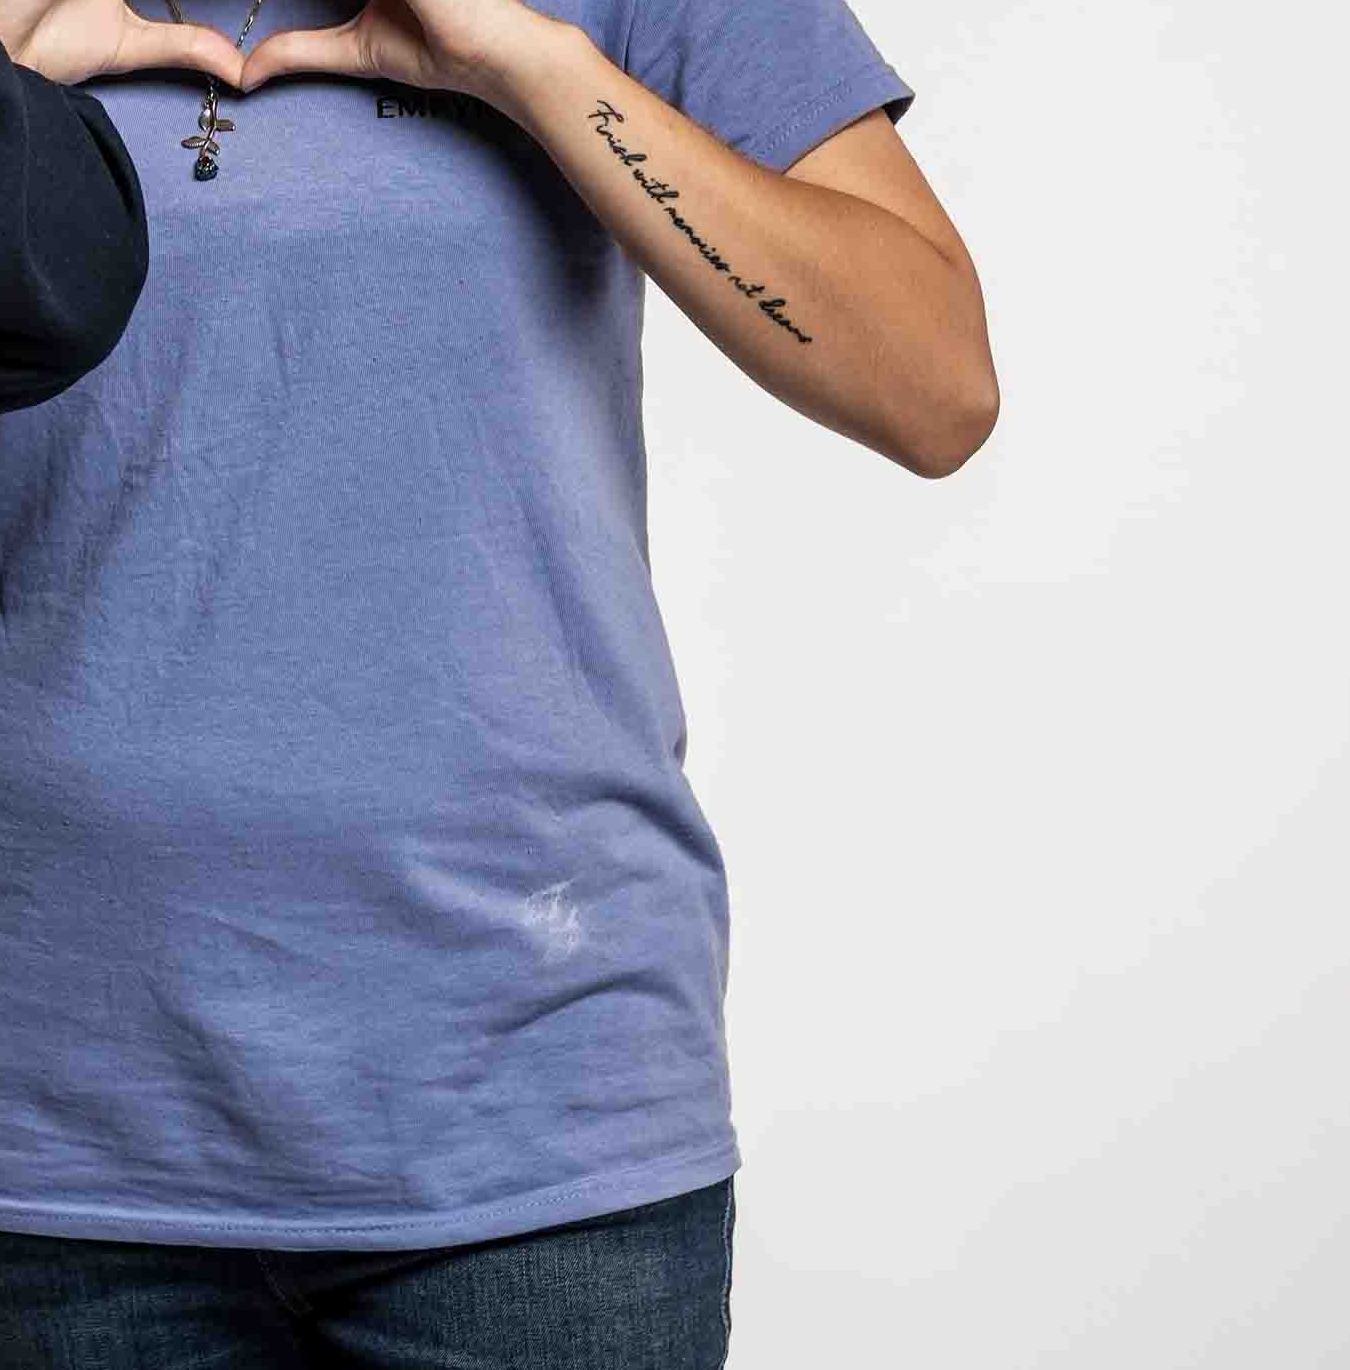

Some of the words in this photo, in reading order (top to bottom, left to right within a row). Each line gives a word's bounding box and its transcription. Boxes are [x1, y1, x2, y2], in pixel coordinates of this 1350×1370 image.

[632, 168, 680, 205] with
[664, 206, 732, 273] memories
[727, 274, 766, 300] not
